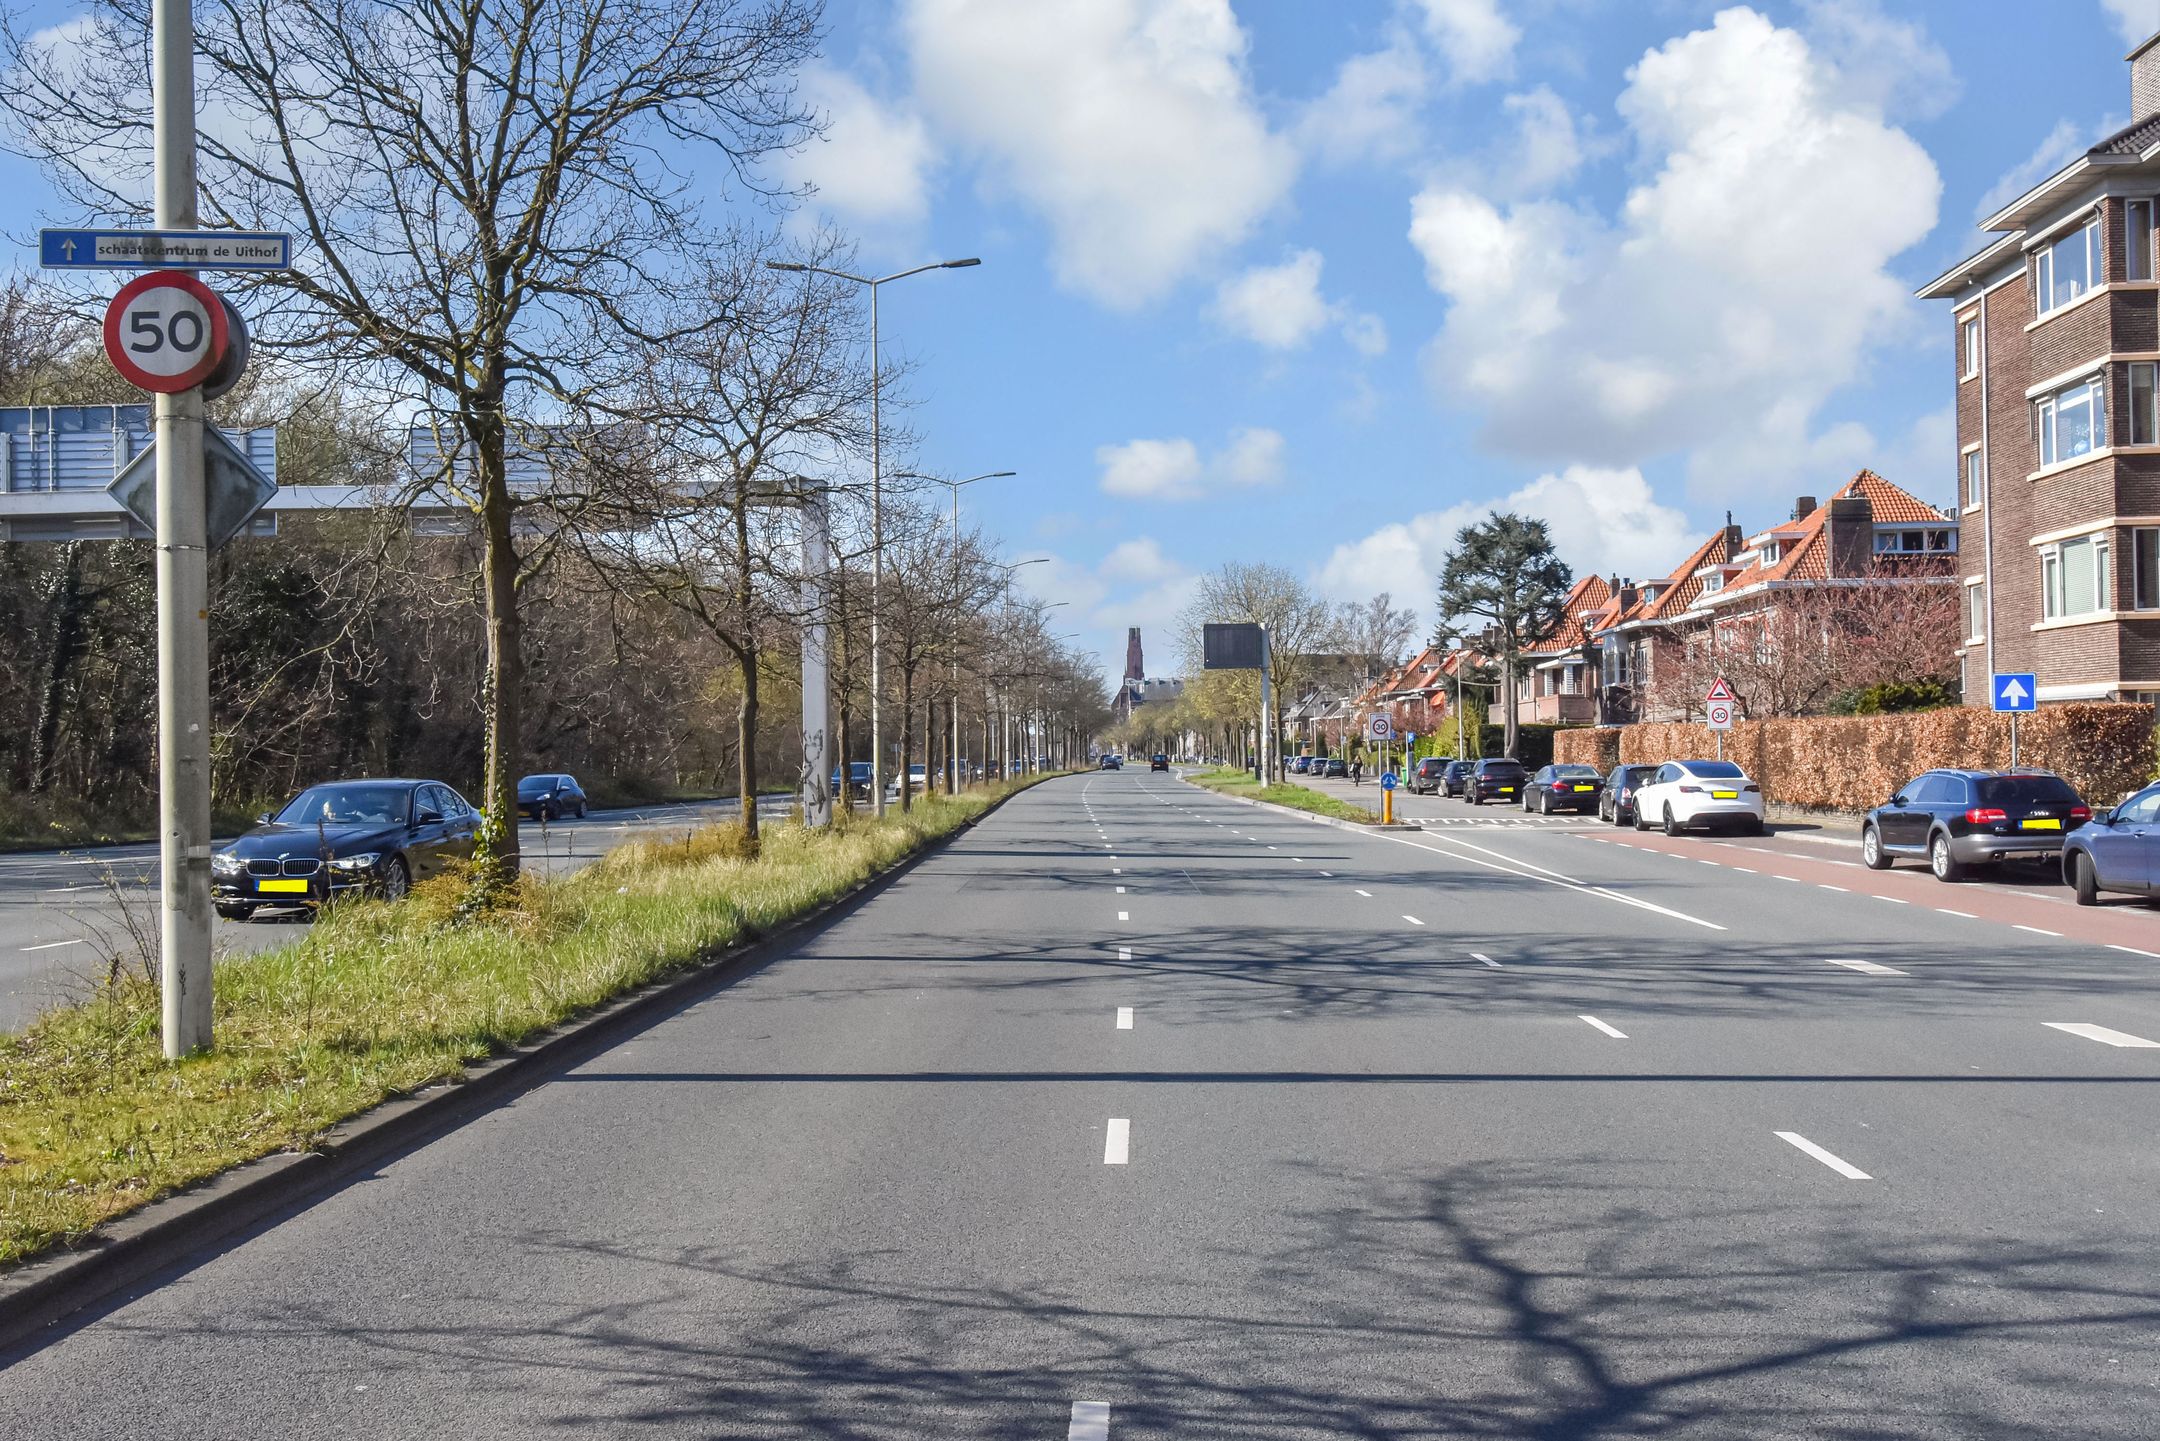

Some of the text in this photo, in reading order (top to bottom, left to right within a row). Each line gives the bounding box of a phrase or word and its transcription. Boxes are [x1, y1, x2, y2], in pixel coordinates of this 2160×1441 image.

[99, 244, 278, 258] schaatscentrum de Uithof
[130, 310, 203, 354] 50
[1376, 723, 1386, 731] 30
